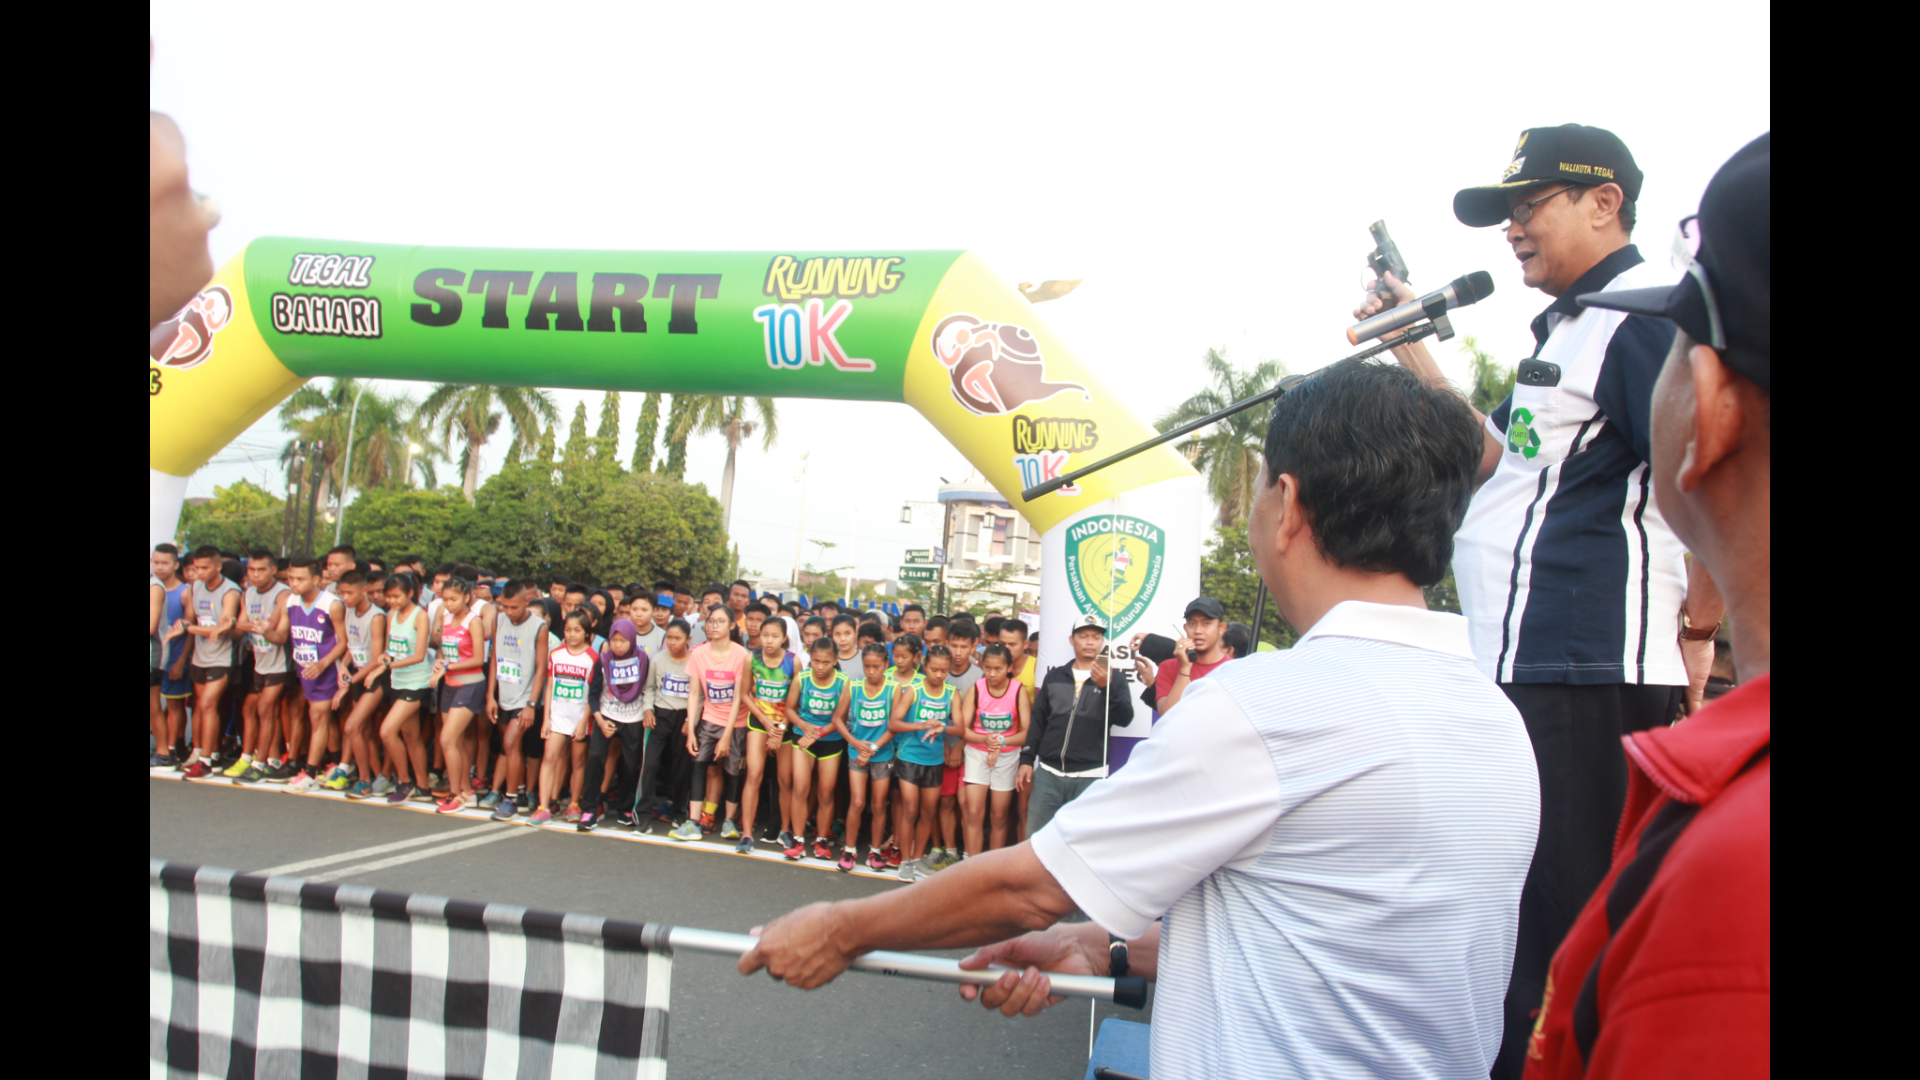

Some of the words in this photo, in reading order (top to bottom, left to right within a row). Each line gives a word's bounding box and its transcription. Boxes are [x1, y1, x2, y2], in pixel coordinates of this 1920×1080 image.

[1559, 161, 1592, 174] WALIKOTA
[1594, 165, 1615, 179] TEGAL
[289, 253, 374, 287] TEGAL
[765, 255, 904, 301] RUNNING
[409, 268, 722, 334] START
[273, 293, 381, 337] BAHARI
[756, 300, 874, 370] 10K
[1014, 416, 1097, 453] RUNNING
[1015, 453, 1078, 492] 10K
[1070, 518, 1158, 543] INDONESIA
[1068, 555, 1087, 603] Persatuan
[1113, 602, 1145, 632] Seluruh
[1140, 555, 1163, 601] Indonesia
[291, 625, 324, 644] SEVEN
[612, 665, 639, 678] 0212
[556, 686, 583, 698] 0018
[758, 687, 787, 698] 0027
[808, 698, 836, 710] 0031
[860, 709, 886, 720] 0030
[919, 708, 947, 719] 0028
[982, 720, 1011, 729] 0029
